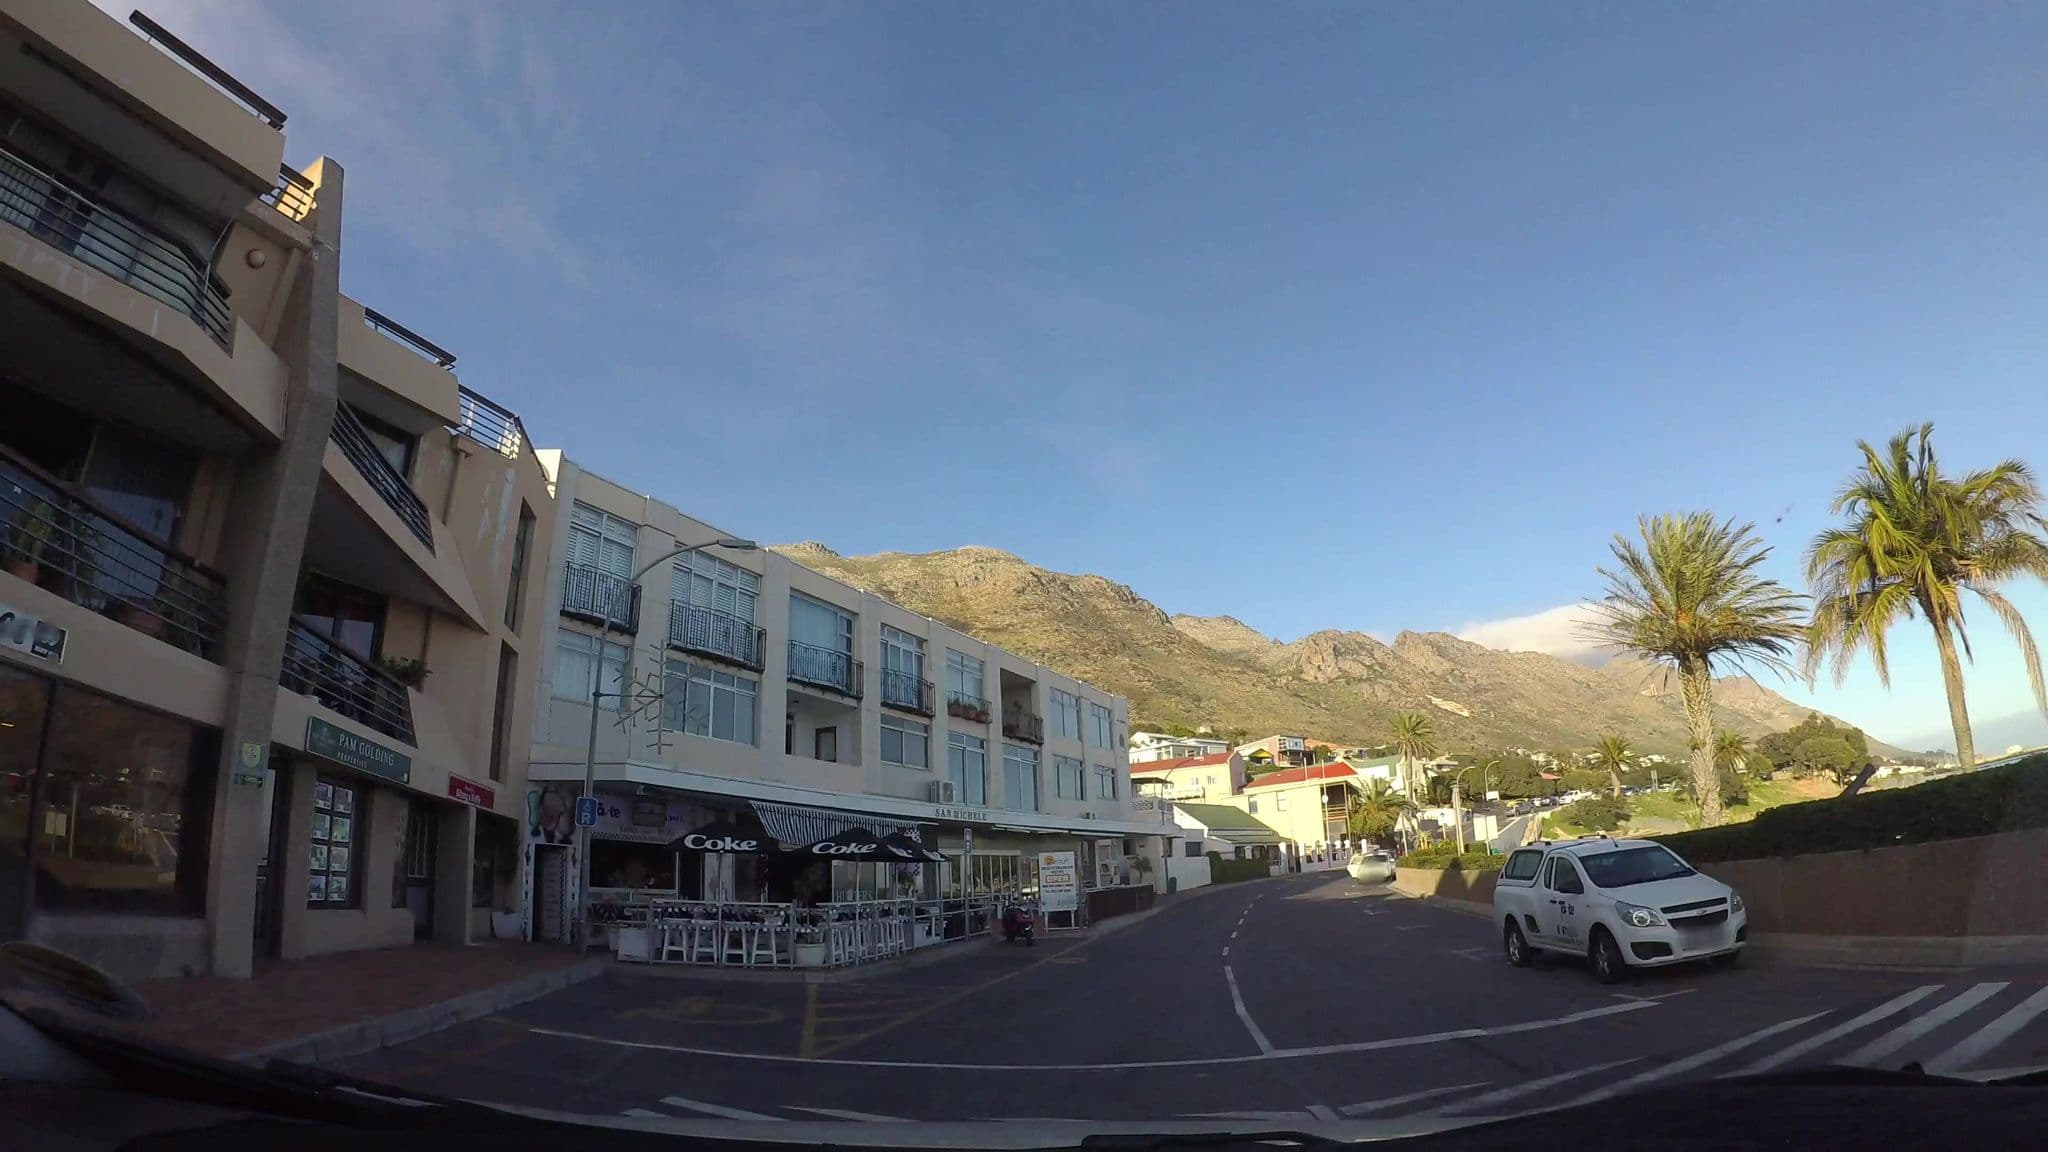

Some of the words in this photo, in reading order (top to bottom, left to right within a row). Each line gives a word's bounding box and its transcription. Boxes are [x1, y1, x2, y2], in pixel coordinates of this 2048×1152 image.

[339, 734, 357, 751] PAM
[360, 743, 394, 766] GOLDING
[935, 808, 952, 818] SAN
[953, 810, 987, 821] MICHELE
[684, 834, 758, 851] Coke
[811, 842, 877, 855] Coke
[1046, 874, 1069, 882] OPEN
